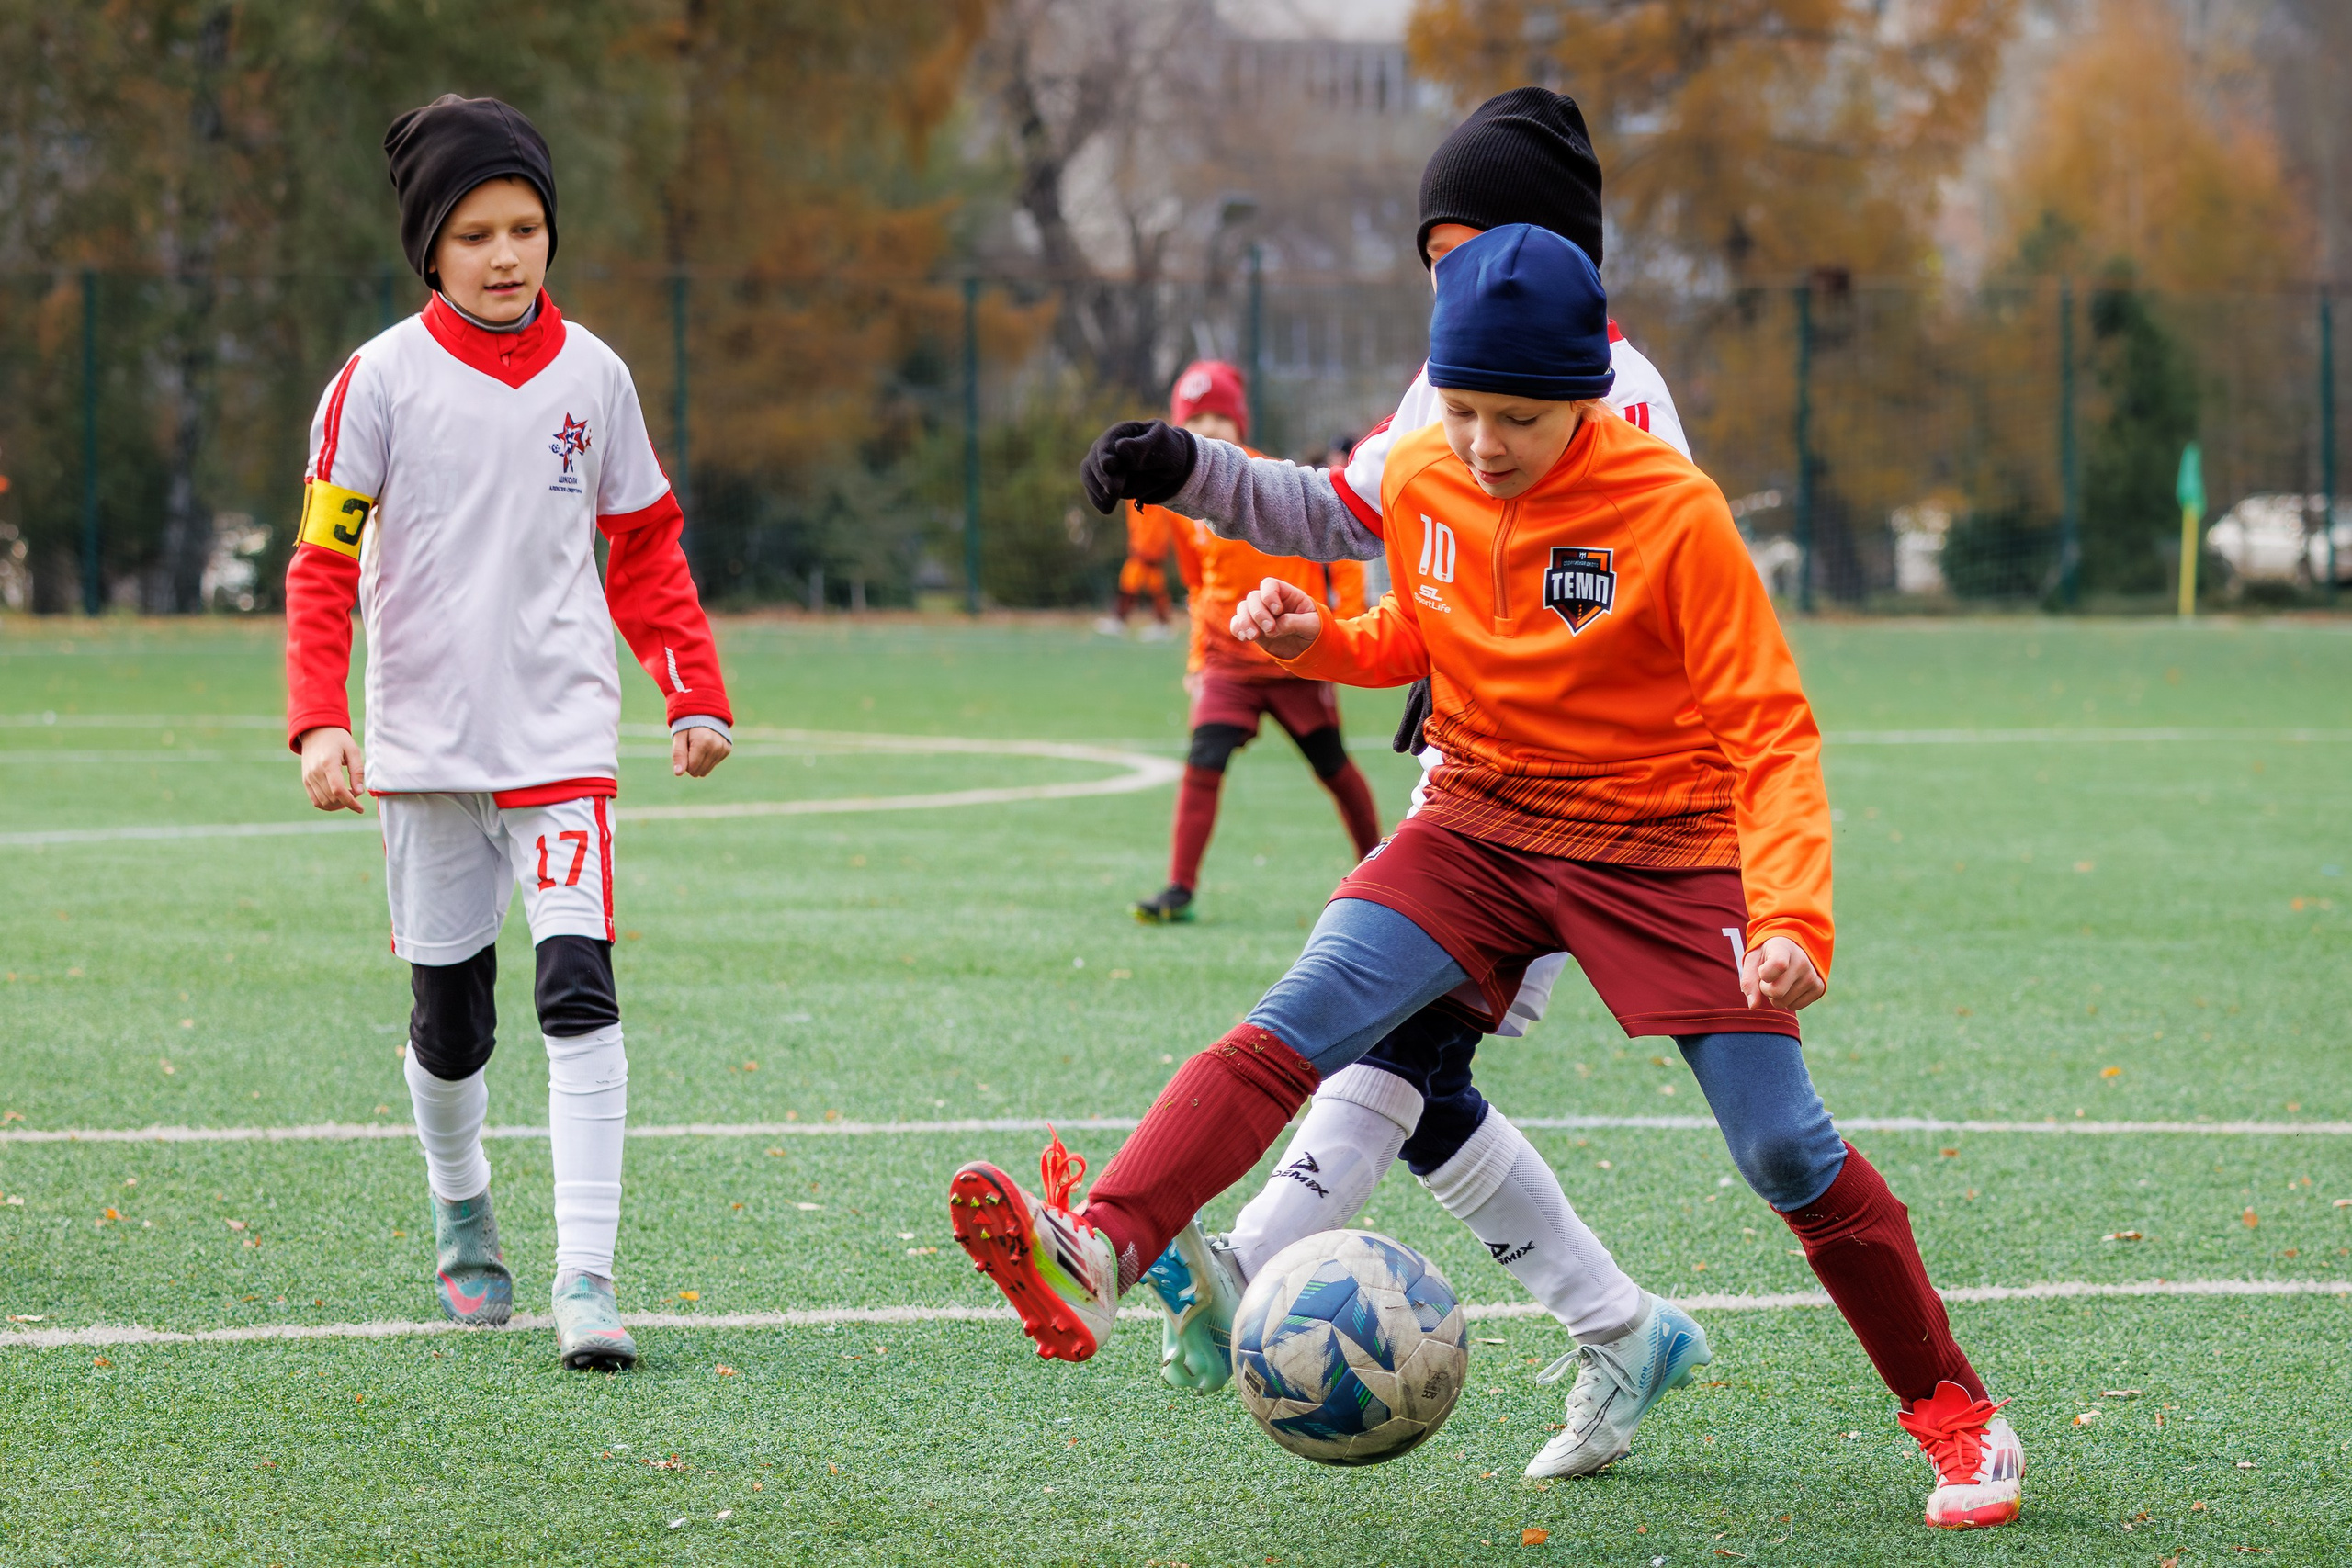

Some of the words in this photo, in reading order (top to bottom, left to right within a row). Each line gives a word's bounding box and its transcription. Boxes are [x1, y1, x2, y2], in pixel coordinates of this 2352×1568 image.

[1418, 513, 1456, 583] 10
[1414, 592, 1452, 614] SportLife
[1551, 571, 1610, 604] ТЕМП
[536, 830, 588, 893] 17
